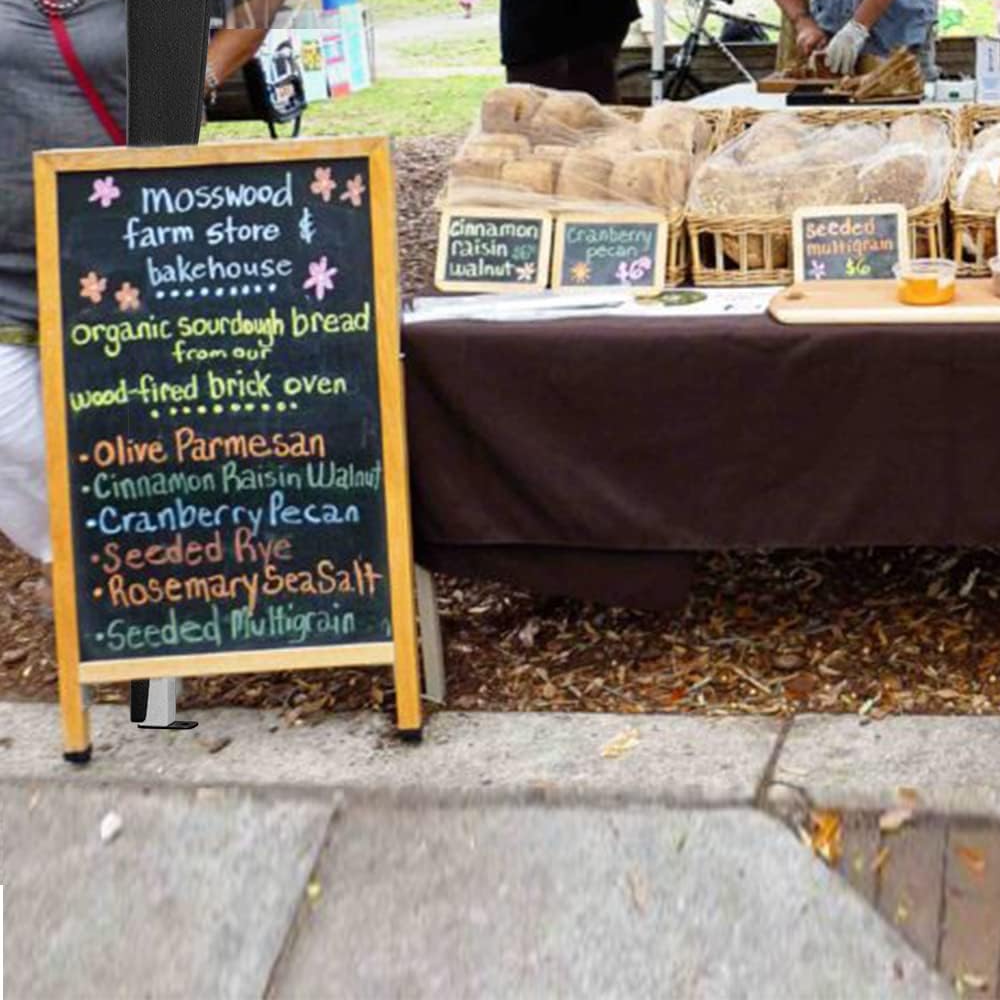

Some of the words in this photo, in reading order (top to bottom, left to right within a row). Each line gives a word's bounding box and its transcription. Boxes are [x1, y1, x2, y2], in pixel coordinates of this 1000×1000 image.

[123, 217, 194, 250] farm
[206, 215, 280, 244] store
[451, 239, 508, 257] raisin
[806, 237, 893, 258] multigrain
[147, 253, 293, 287] bakehouse
[449, 257, 514, 277] walnut
[586, 246, 638, 264] pecan
[845, 257, 871, 277] $6
[71, 315, 172, 357] organic
[177, 308, 284, 347] sourdough
[291, 302, 371, 338] bread
[172, 339, 227, 363] from
[233, 346, 272, 361] our
[70, 373, 198, 411] wood-fired
[208, 370, 272, 400] brick
[284, 375, 347, 396] oven
[94, 435, 168, 467] Olive
[175, 427, 326, 462] Parmesan
[94, 470, 216, 500] Cinnamon
[222, 460, 301, 493] Raisin
[306, 460, 382, 490] Walnut
[99, 498, 263, 537] Cranberry
[270, 490, 360, 526] Pecan
[103, 530, 222, 574] Seeded
[234, 526, 293, 565] Rye
[109, 572, 258, 616] Rosemary
[107, 604, 221, 650] Seeded
[231, 602, 356, 644] Multigrain
